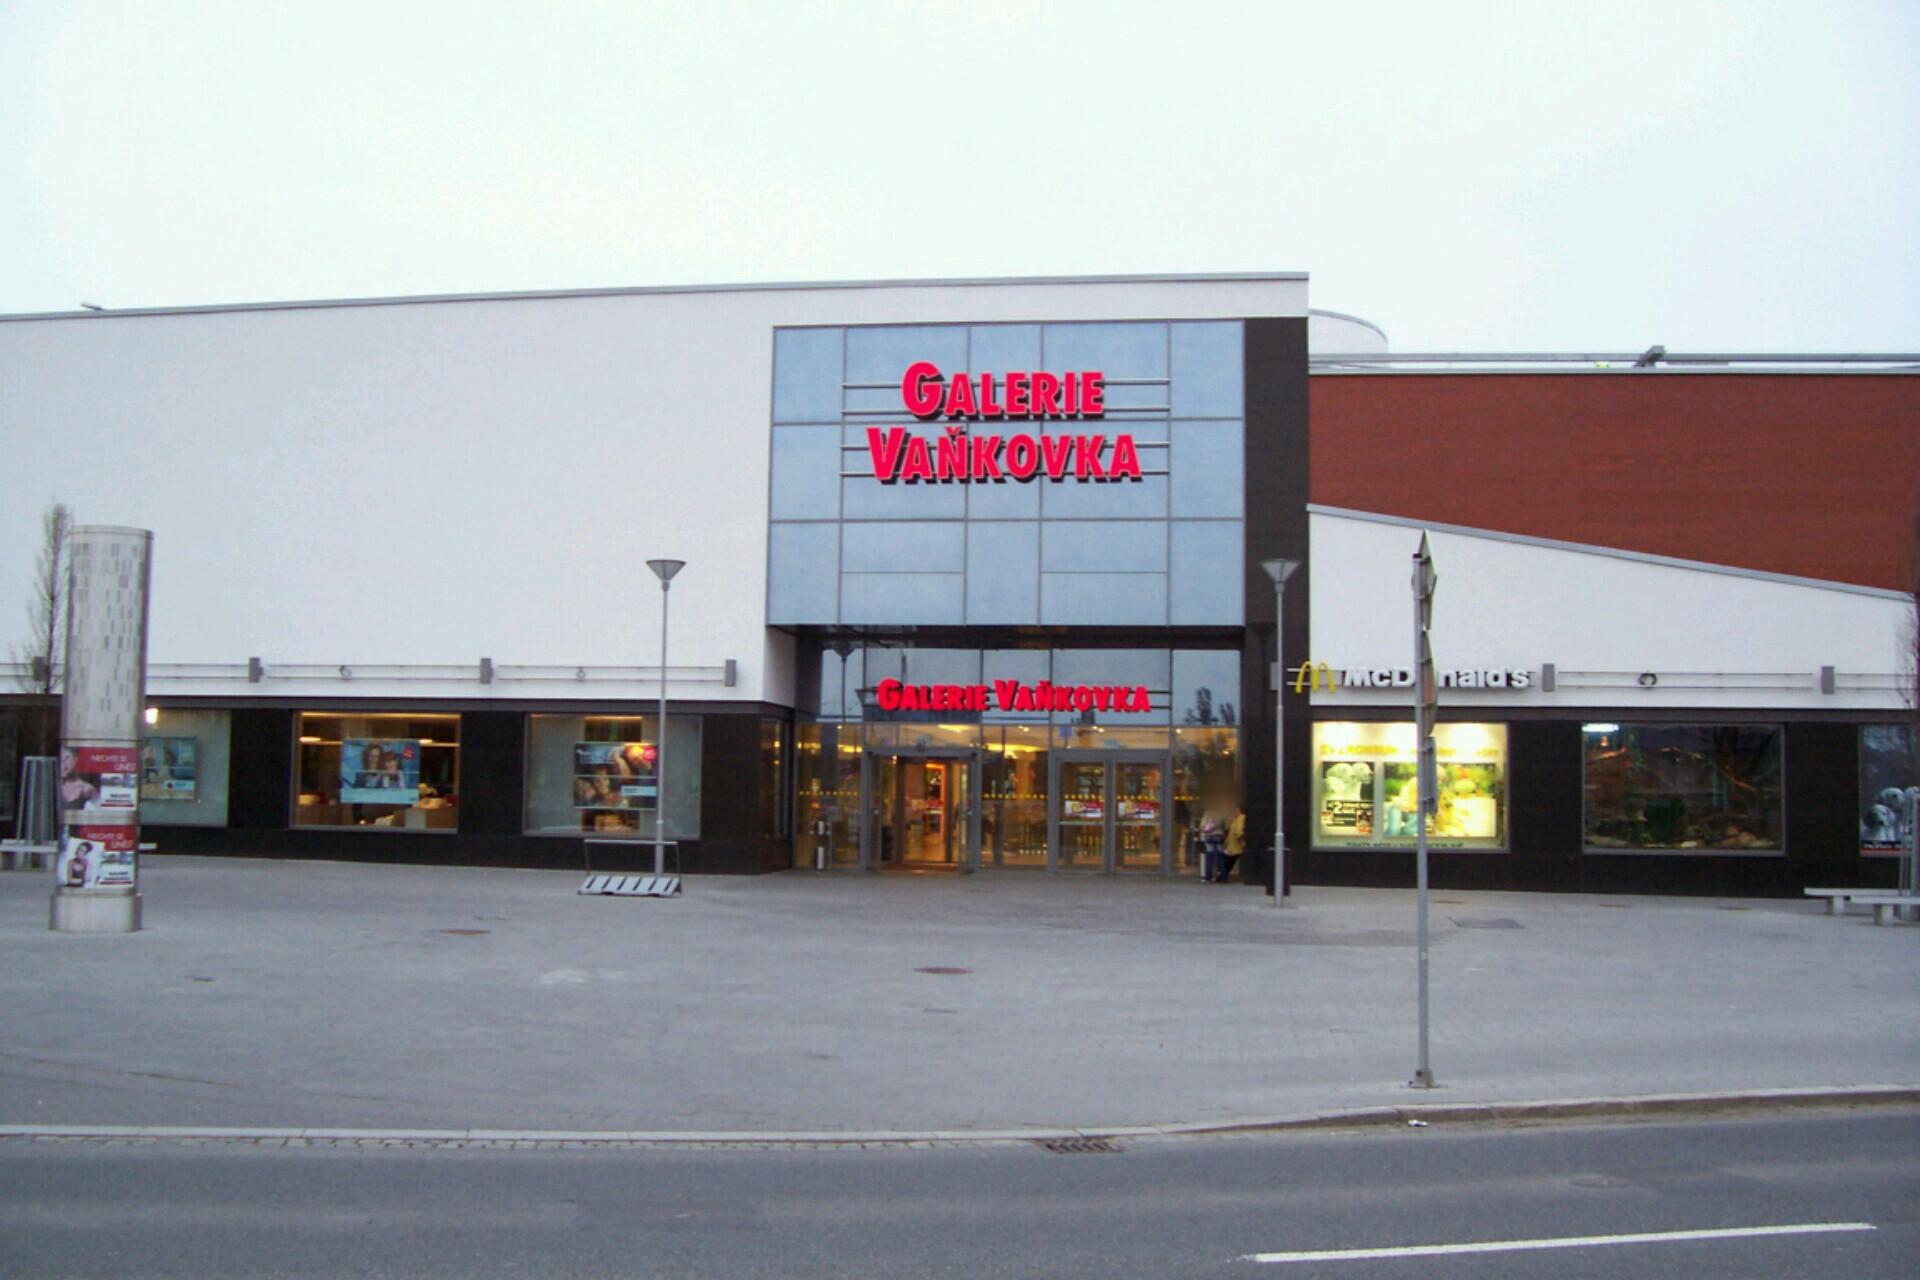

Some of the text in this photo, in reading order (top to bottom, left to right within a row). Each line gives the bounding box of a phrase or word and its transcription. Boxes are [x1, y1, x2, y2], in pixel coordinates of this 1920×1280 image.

[901, 361, 1105, 416] GALERIE
[866, 426, 1142, 481] VAŇKOVKA
[877, 678, 1151, 712] GALERIE VAŇKOVKA
[1344, 665, 1531, 688] McDnald's
